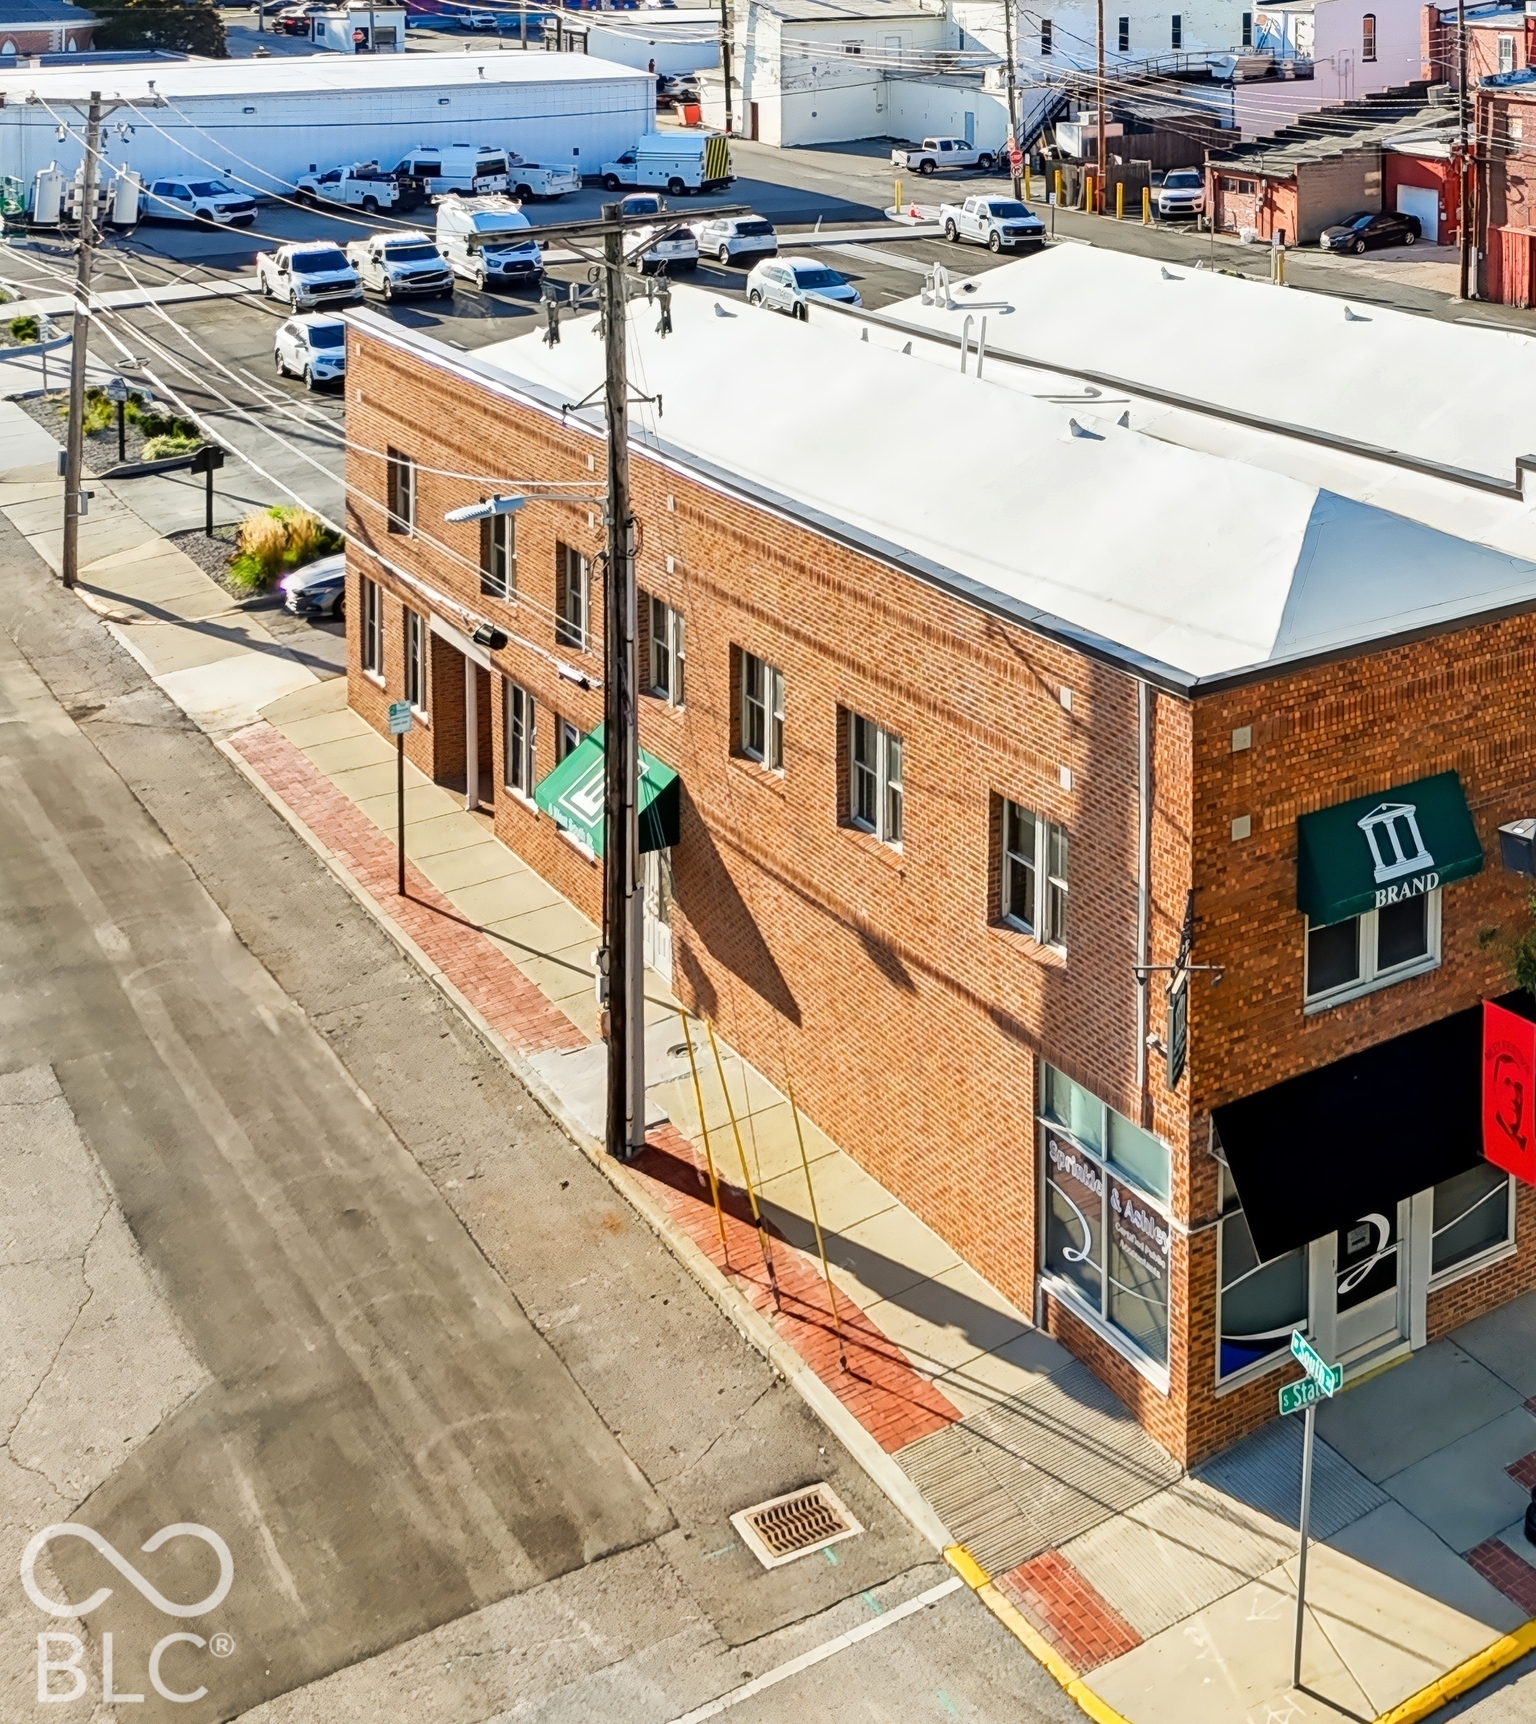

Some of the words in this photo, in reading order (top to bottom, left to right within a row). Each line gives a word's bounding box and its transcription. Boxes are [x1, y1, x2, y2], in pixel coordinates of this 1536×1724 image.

[1374, 872, 1440, 909] BRAND
[1049, 1140, 1102, 1197] Sprinkle
[1110, 1188, 1122, 1214] &
[1123, 1199, 1169, 1254] Ashley
[1299, 1340, 1326, 1384] South
[1293, 1381, 1325, 1408] Stat
